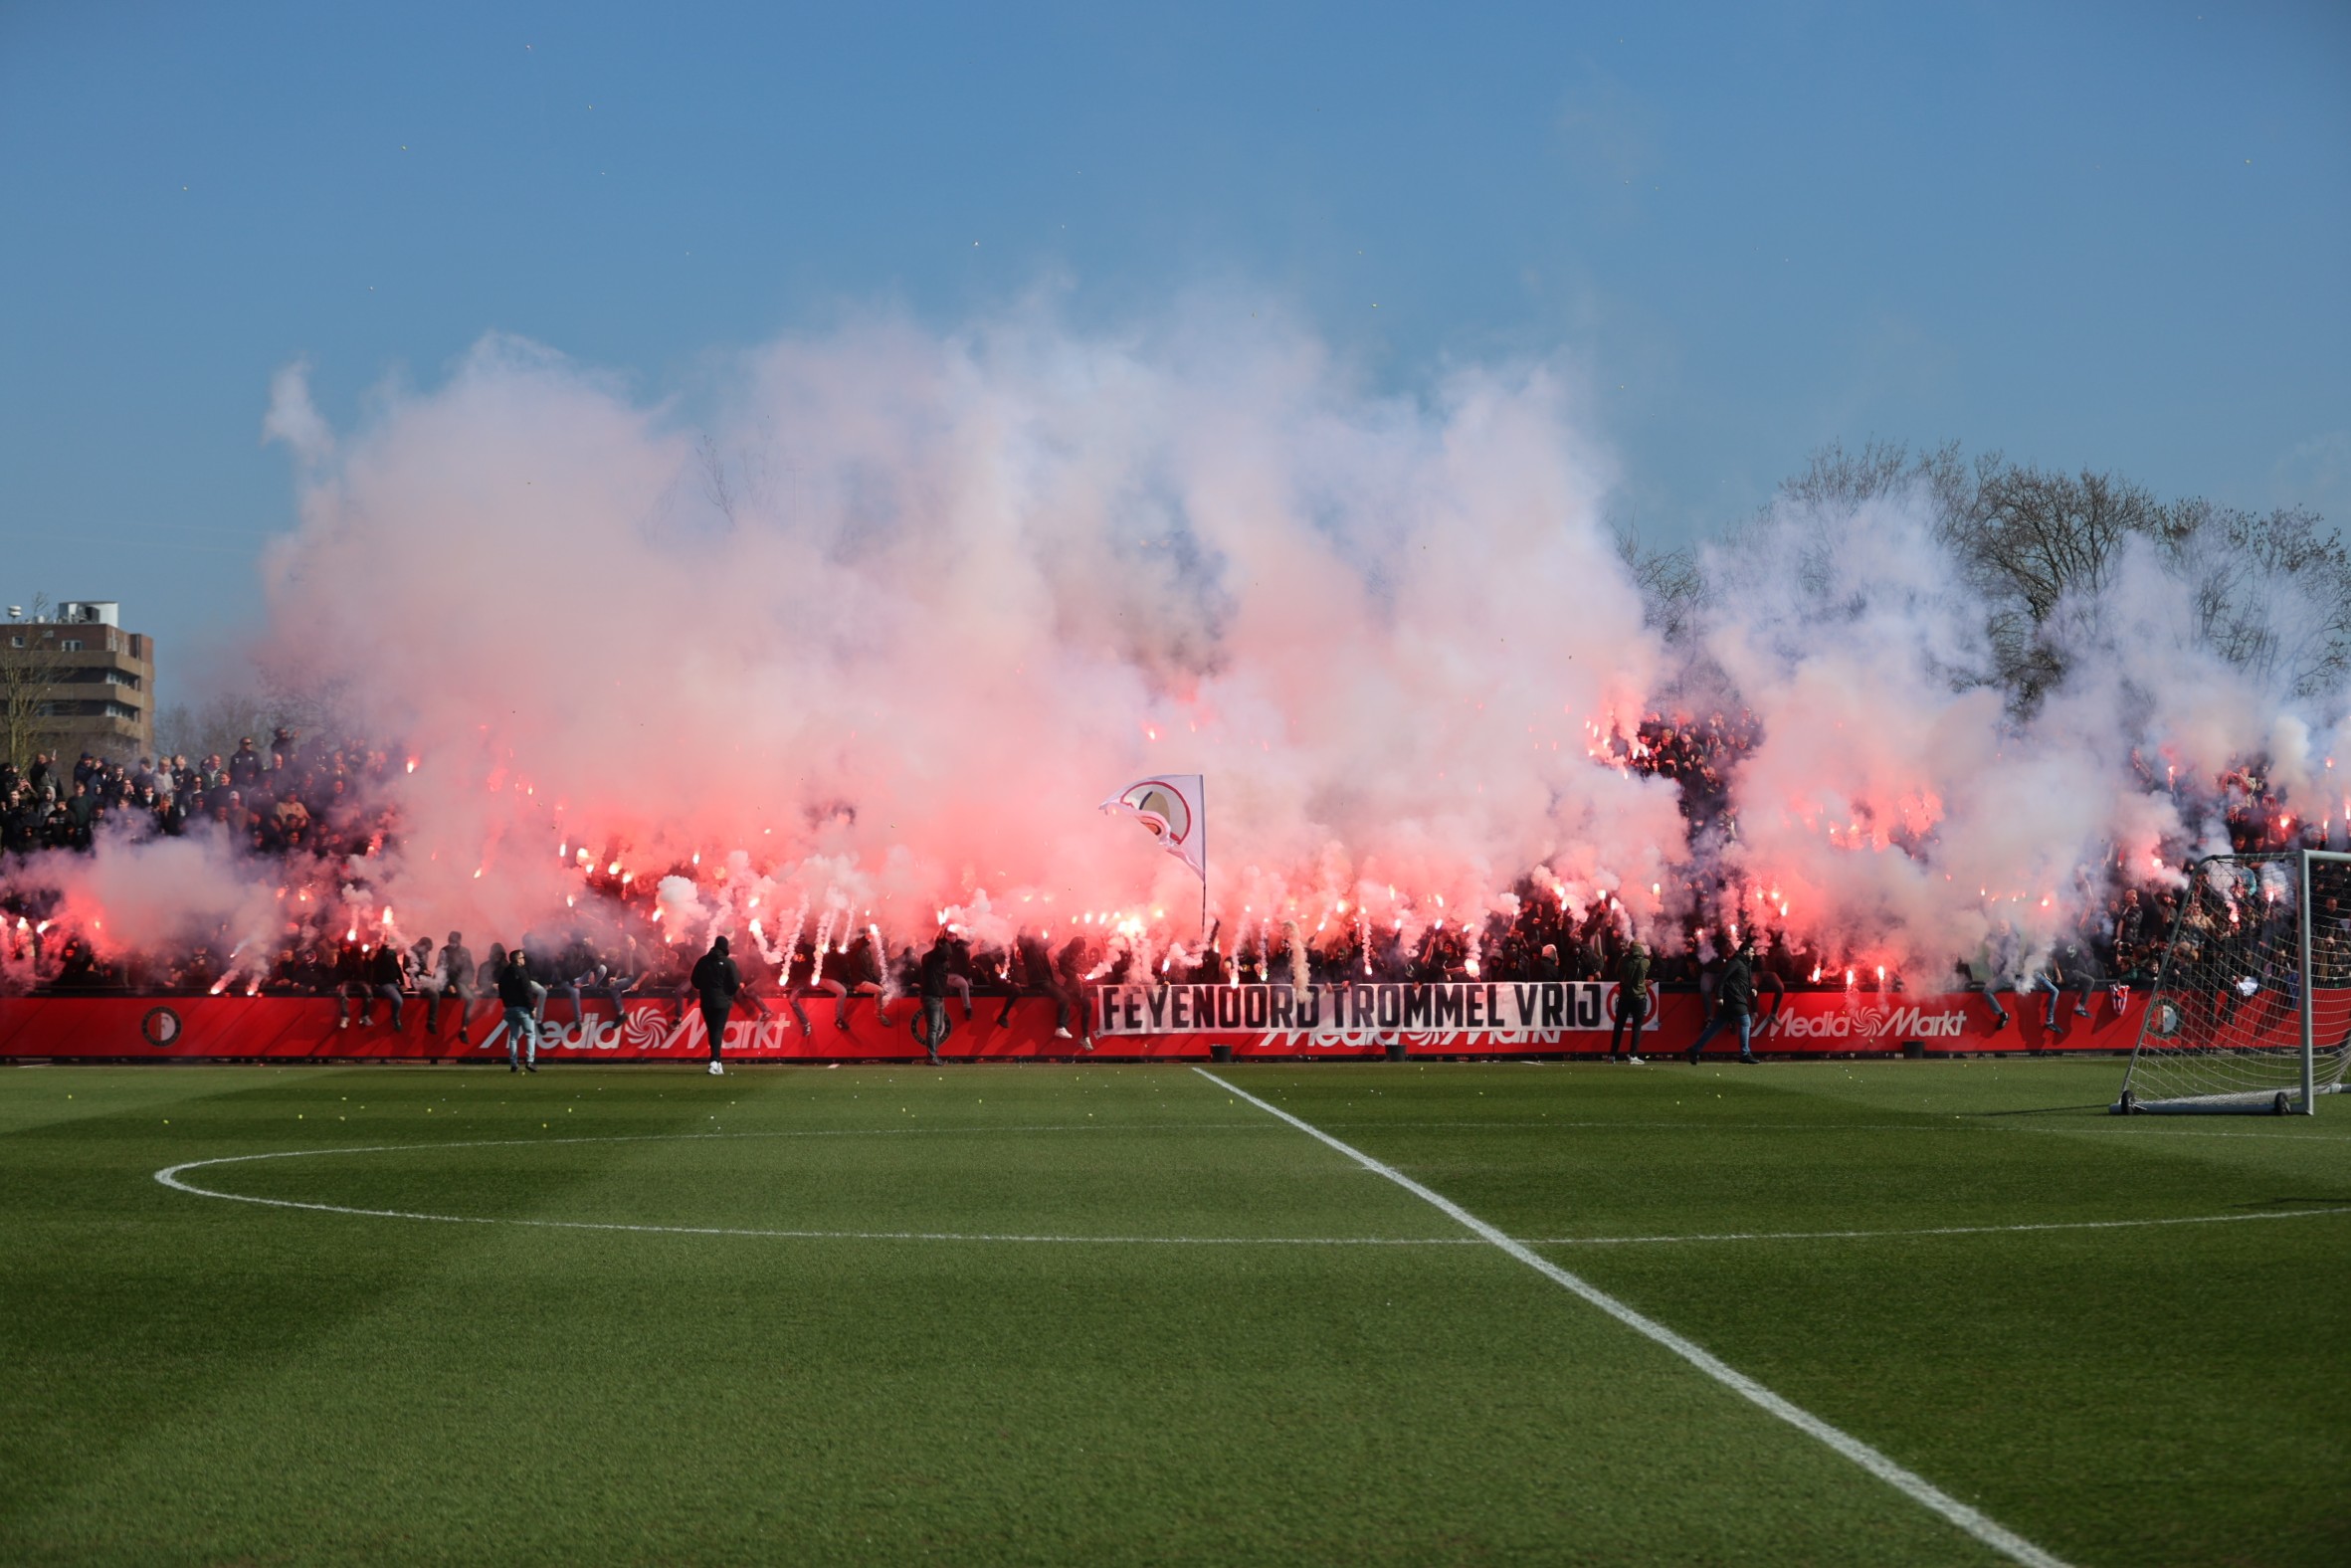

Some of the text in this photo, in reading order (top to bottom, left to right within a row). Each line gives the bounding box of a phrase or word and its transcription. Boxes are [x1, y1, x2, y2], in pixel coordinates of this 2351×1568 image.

[1102, 982, 1601, 1029] FEYENOORD TROMMEL VRIJ
[1751, 1007, 1967, 1038] Media Markt
[660, 1008, 791, 1049] Markt
